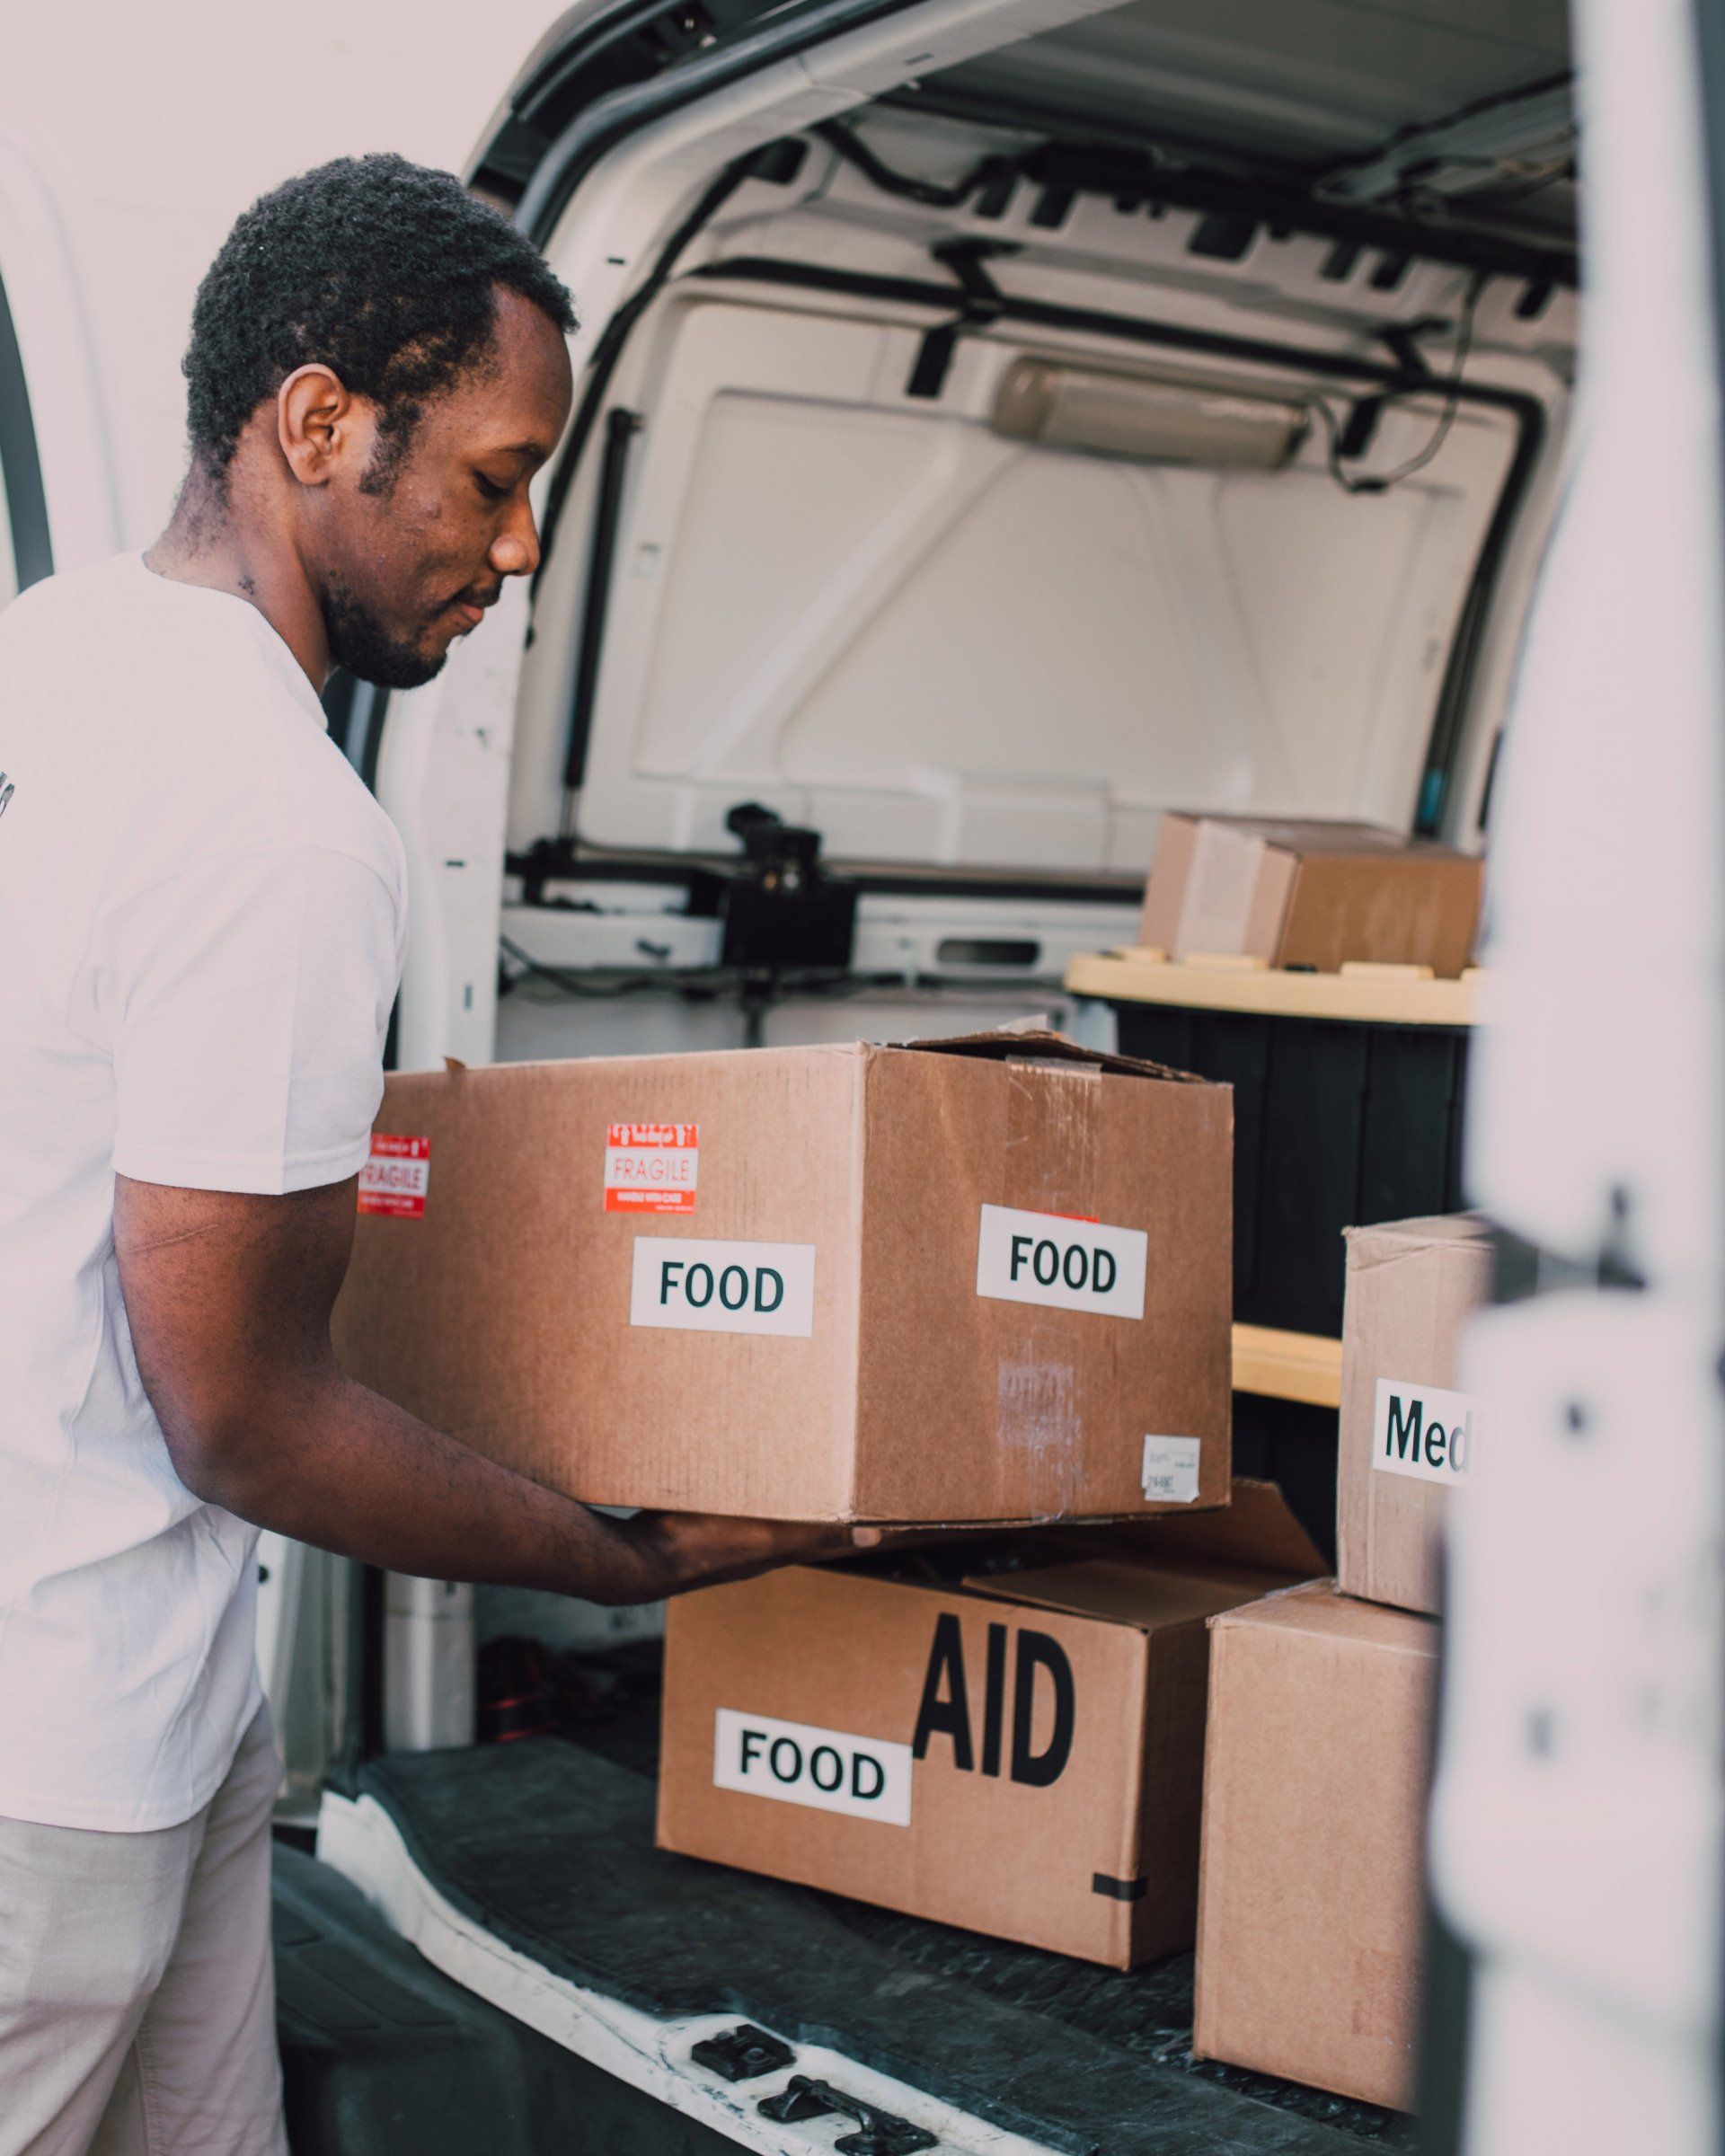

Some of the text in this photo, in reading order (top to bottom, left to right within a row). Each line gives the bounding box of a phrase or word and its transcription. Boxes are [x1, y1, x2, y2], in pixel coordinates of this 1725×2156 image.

[359, 1162, 422, 1189] RAGILE
[615, 1157, 688, 1180] FRAGILE
[660, 1261, 783, 1312] FOOD
[1011, 1235, 1116, 1293] FOOD
[1385, 1395, 1473, 1474] Med
[913, 1613, 1075, 1788] AID
[741, 1729, 885, 1799] FOOD
